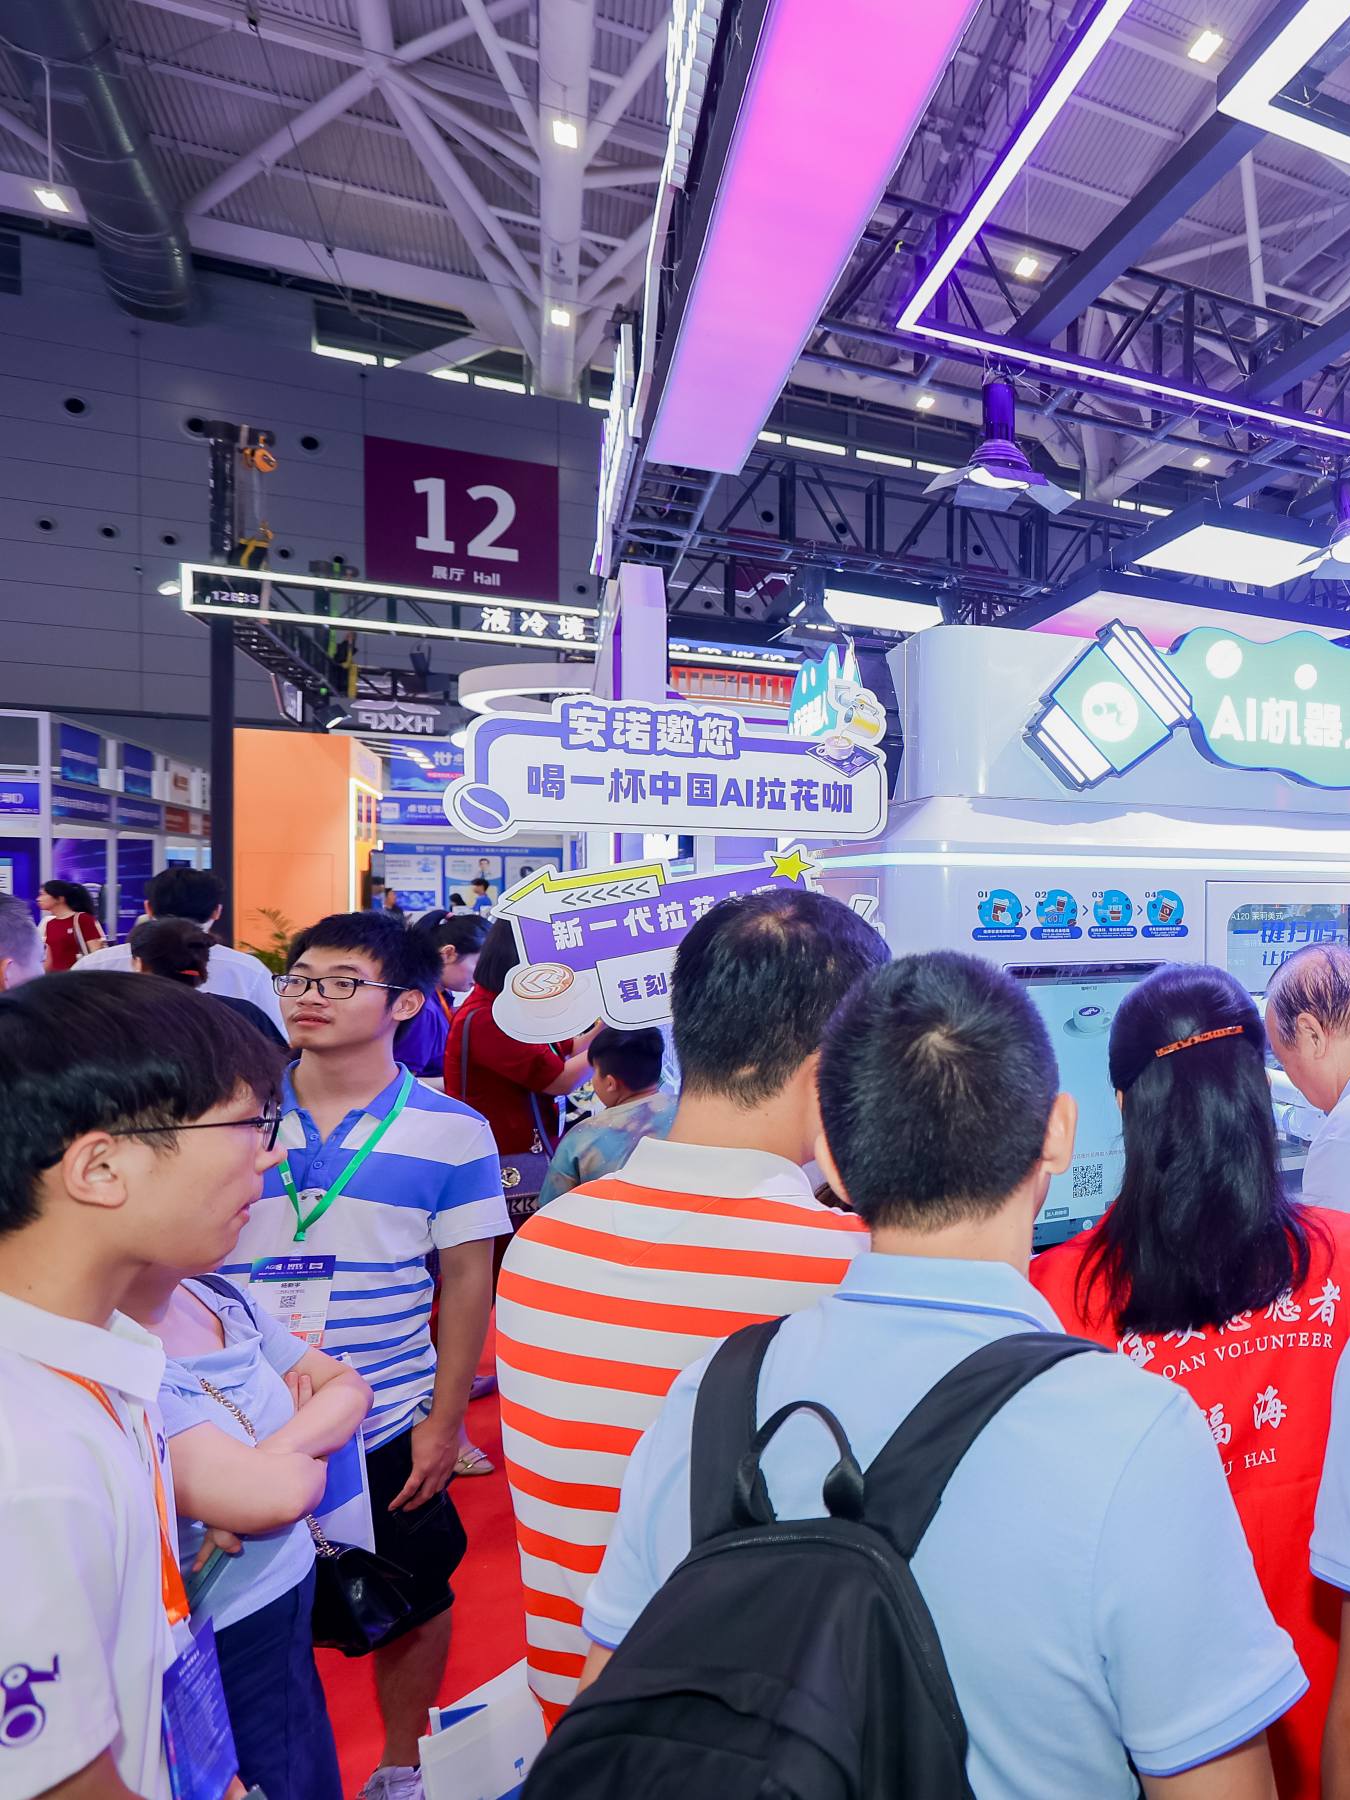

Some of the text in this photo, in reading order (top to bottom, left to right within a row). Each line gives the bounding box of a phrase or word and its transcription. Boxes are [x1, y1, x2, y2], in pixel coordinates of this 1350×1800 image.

[413, 476, 519, 562] 12
[431, 564, 501, 587] 展厅 Hall
[567, 705, 737, 756] 安诺邀您
[526, 763, 854, 815] 喝一杯中国AI拉花咖
[977, 890, 989, 899] 01
[1034, 890, 1047, 899] 02
[1091, 890, 1104, 899] 03
[1144, 890, 1157, 899] 04
[616, 972, 668, 1003] 复刻
[1213, 1331, 1334, 1362] VOLUNTEER
[1244, 1447, 1277, 1469] HAI
